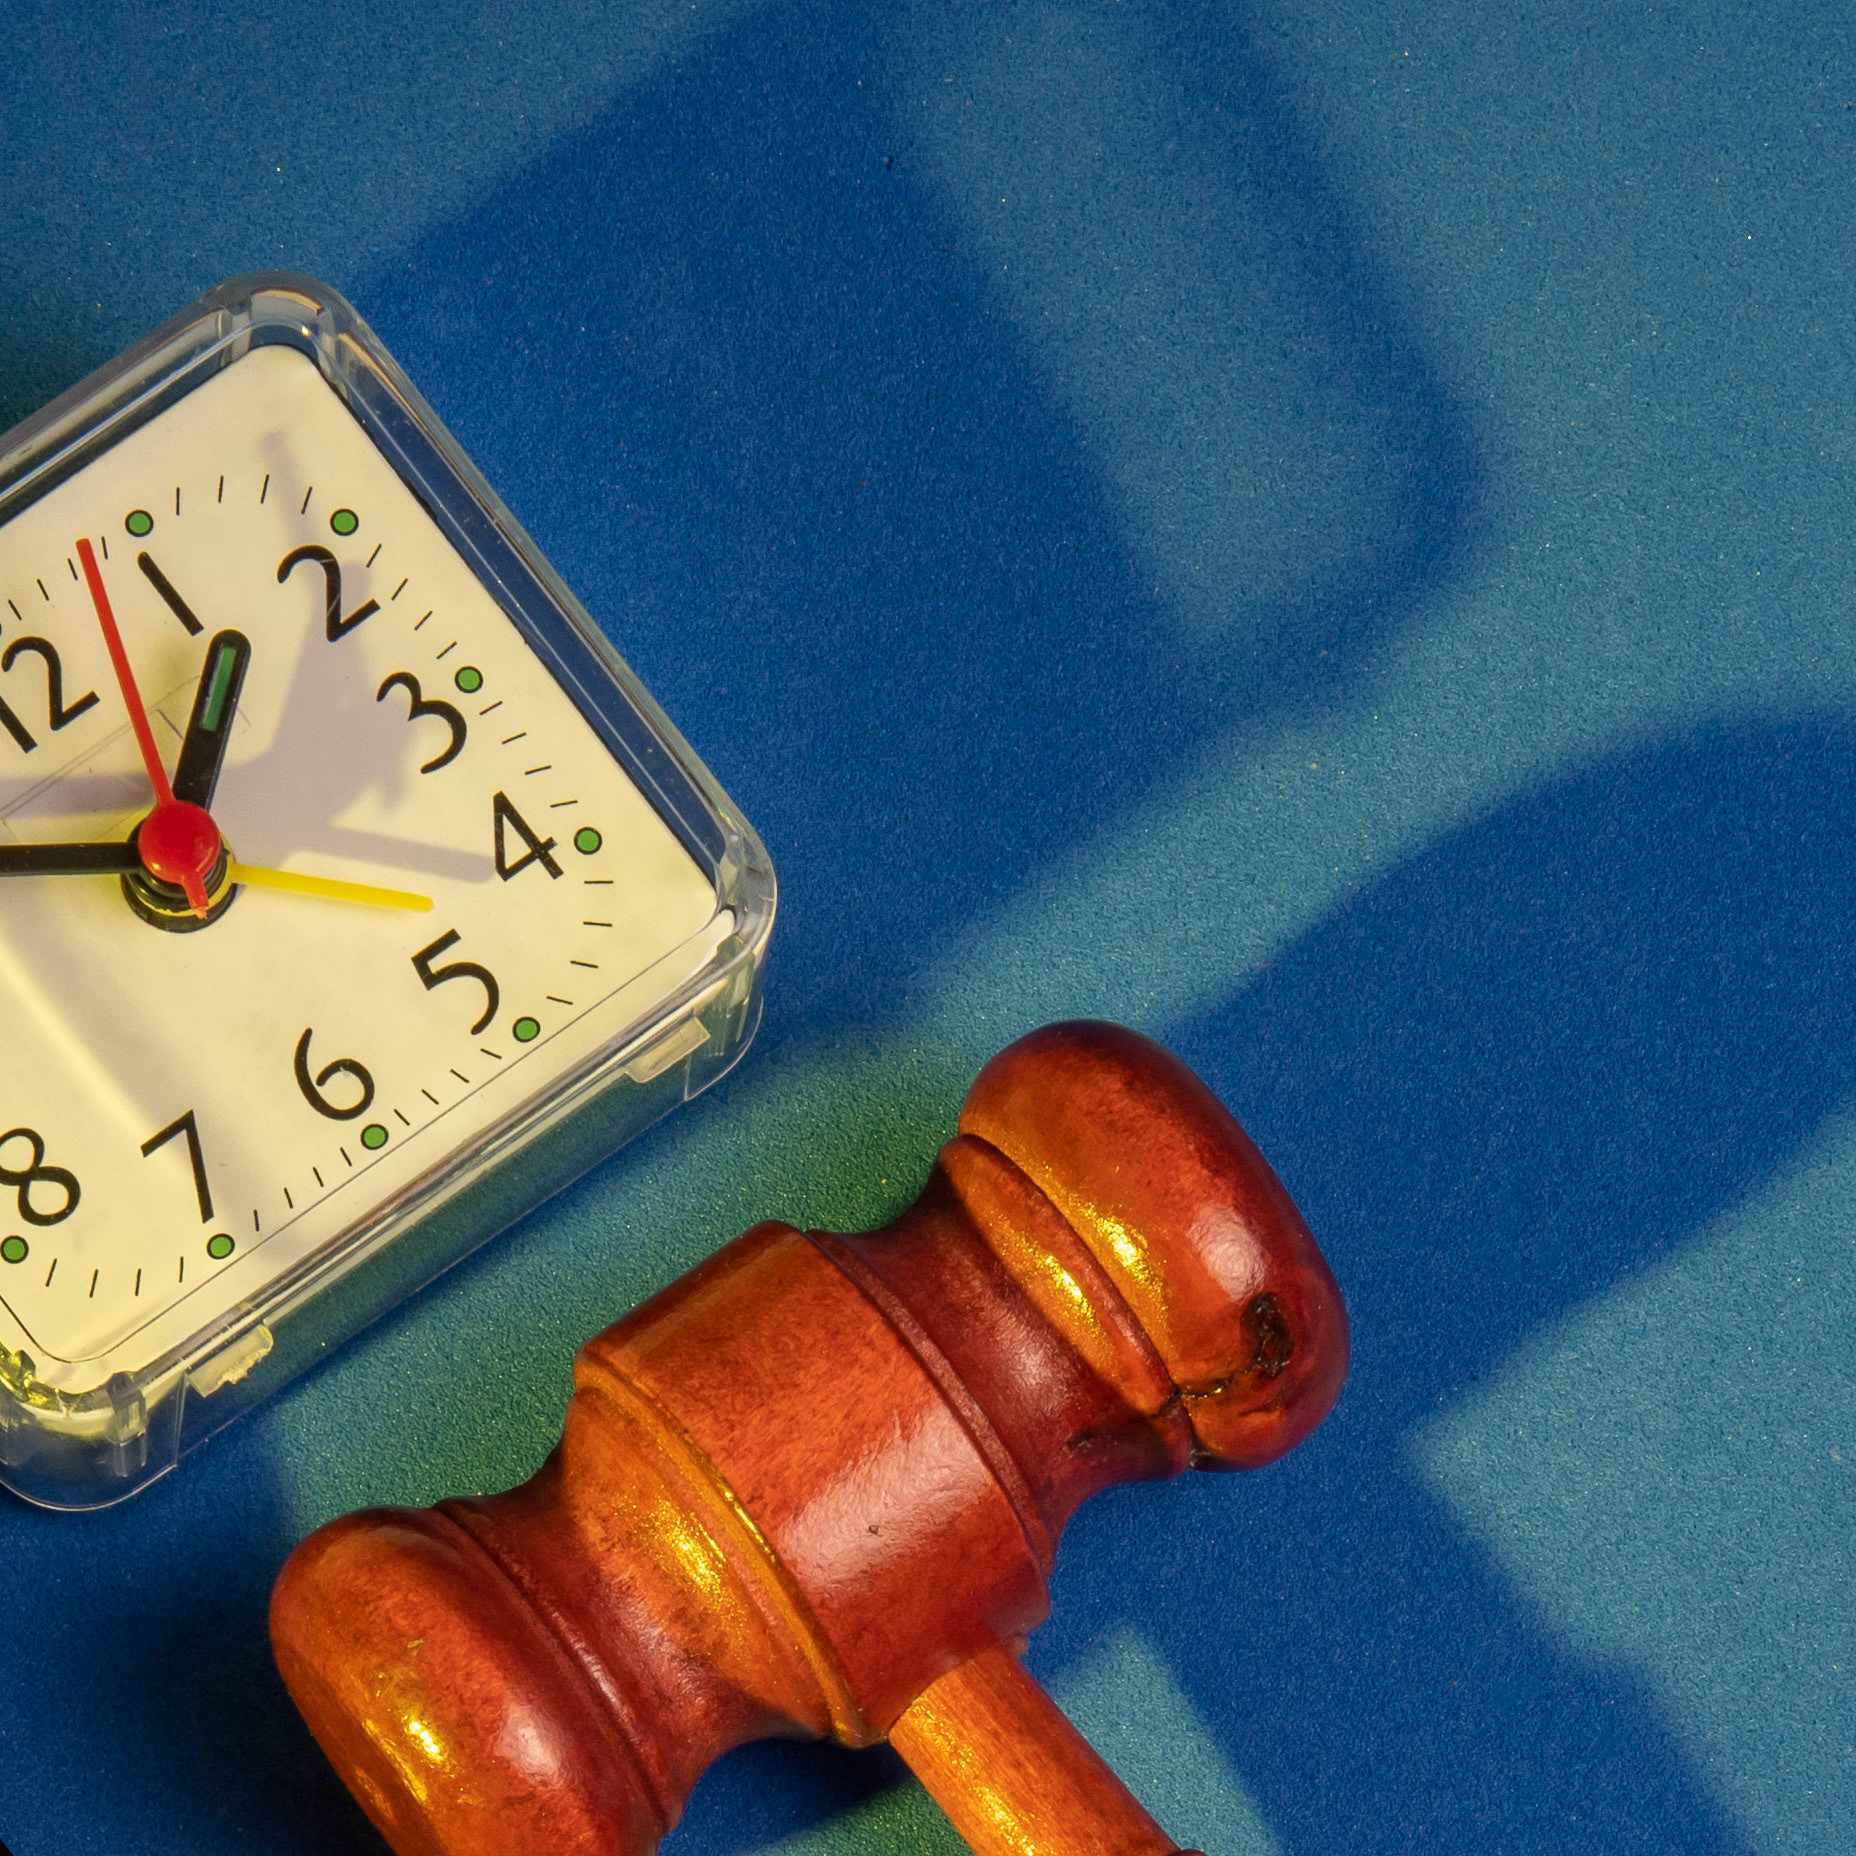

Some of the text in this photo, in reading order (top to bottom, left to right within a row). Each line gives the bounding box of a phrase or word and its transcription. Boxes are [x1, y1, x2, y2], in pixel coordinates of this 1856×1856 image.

[137, 551, 204, 637] 1
[277, 545, 381, 643] 2
[376, 672, 467, 774] 3
[493, 791, 562, 882] 4
[411, 928, 499, 1036] 5
[294, 1028, 375, 1121] 6
[140, 1109, 214, 1224] 7
